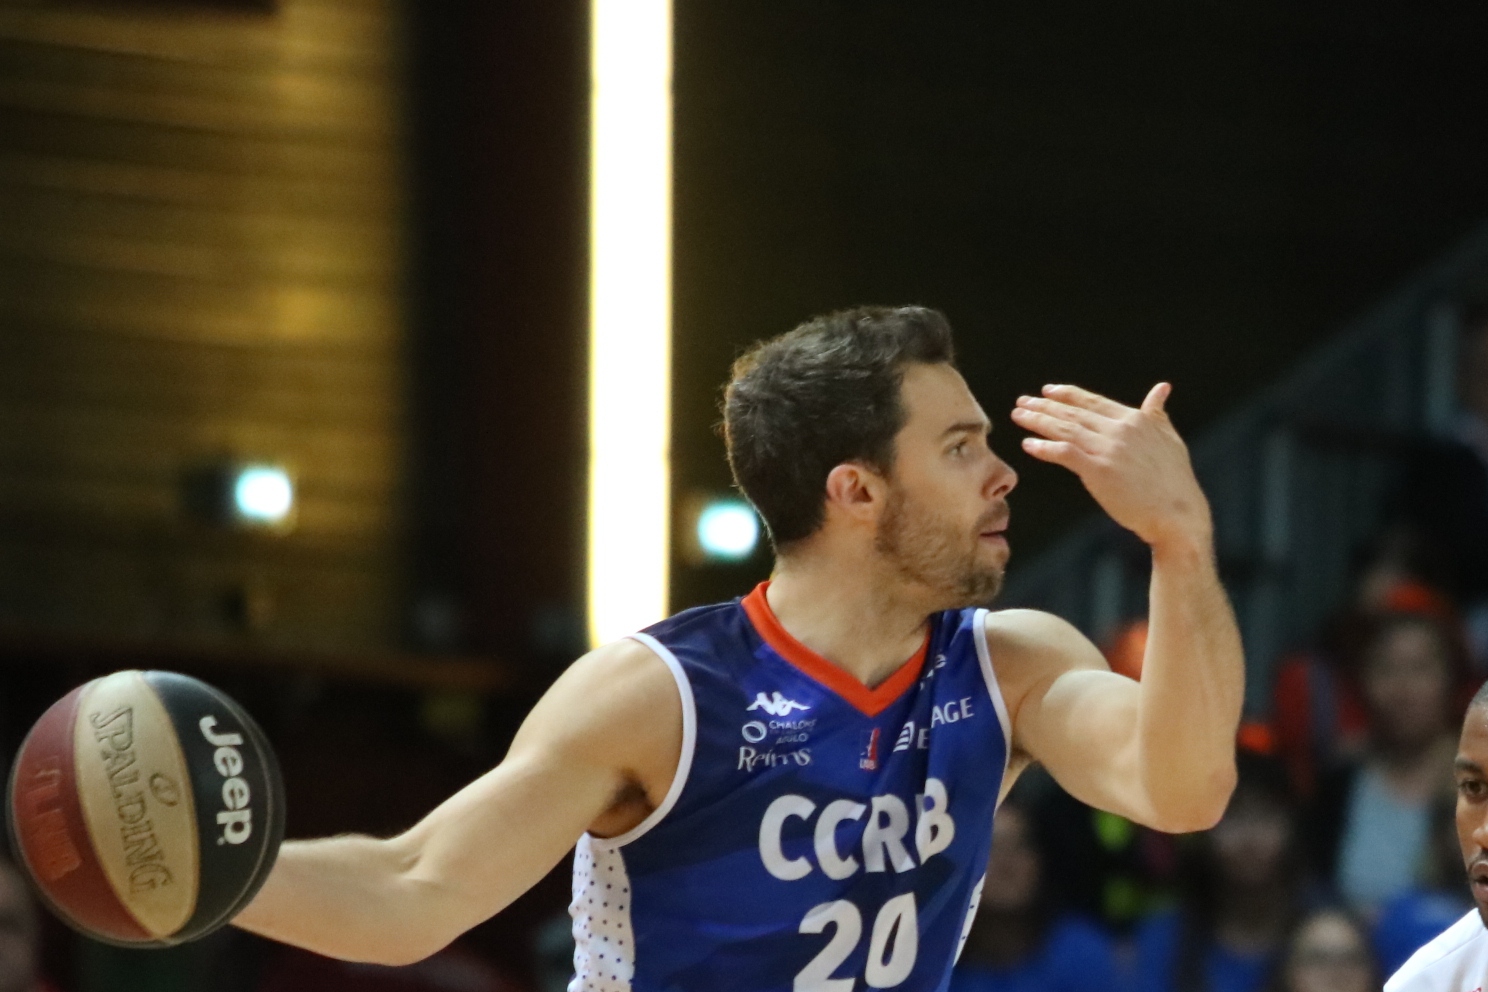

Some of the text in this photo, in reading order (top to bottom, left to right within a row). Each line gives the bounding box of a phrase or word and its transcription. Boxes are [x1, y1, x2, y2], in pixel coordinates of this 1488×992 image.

[90, 706, 173, 894] SPALDING
[199, 714, 252, 846] Jeep
[758, 777, 955, 881] CCRB
